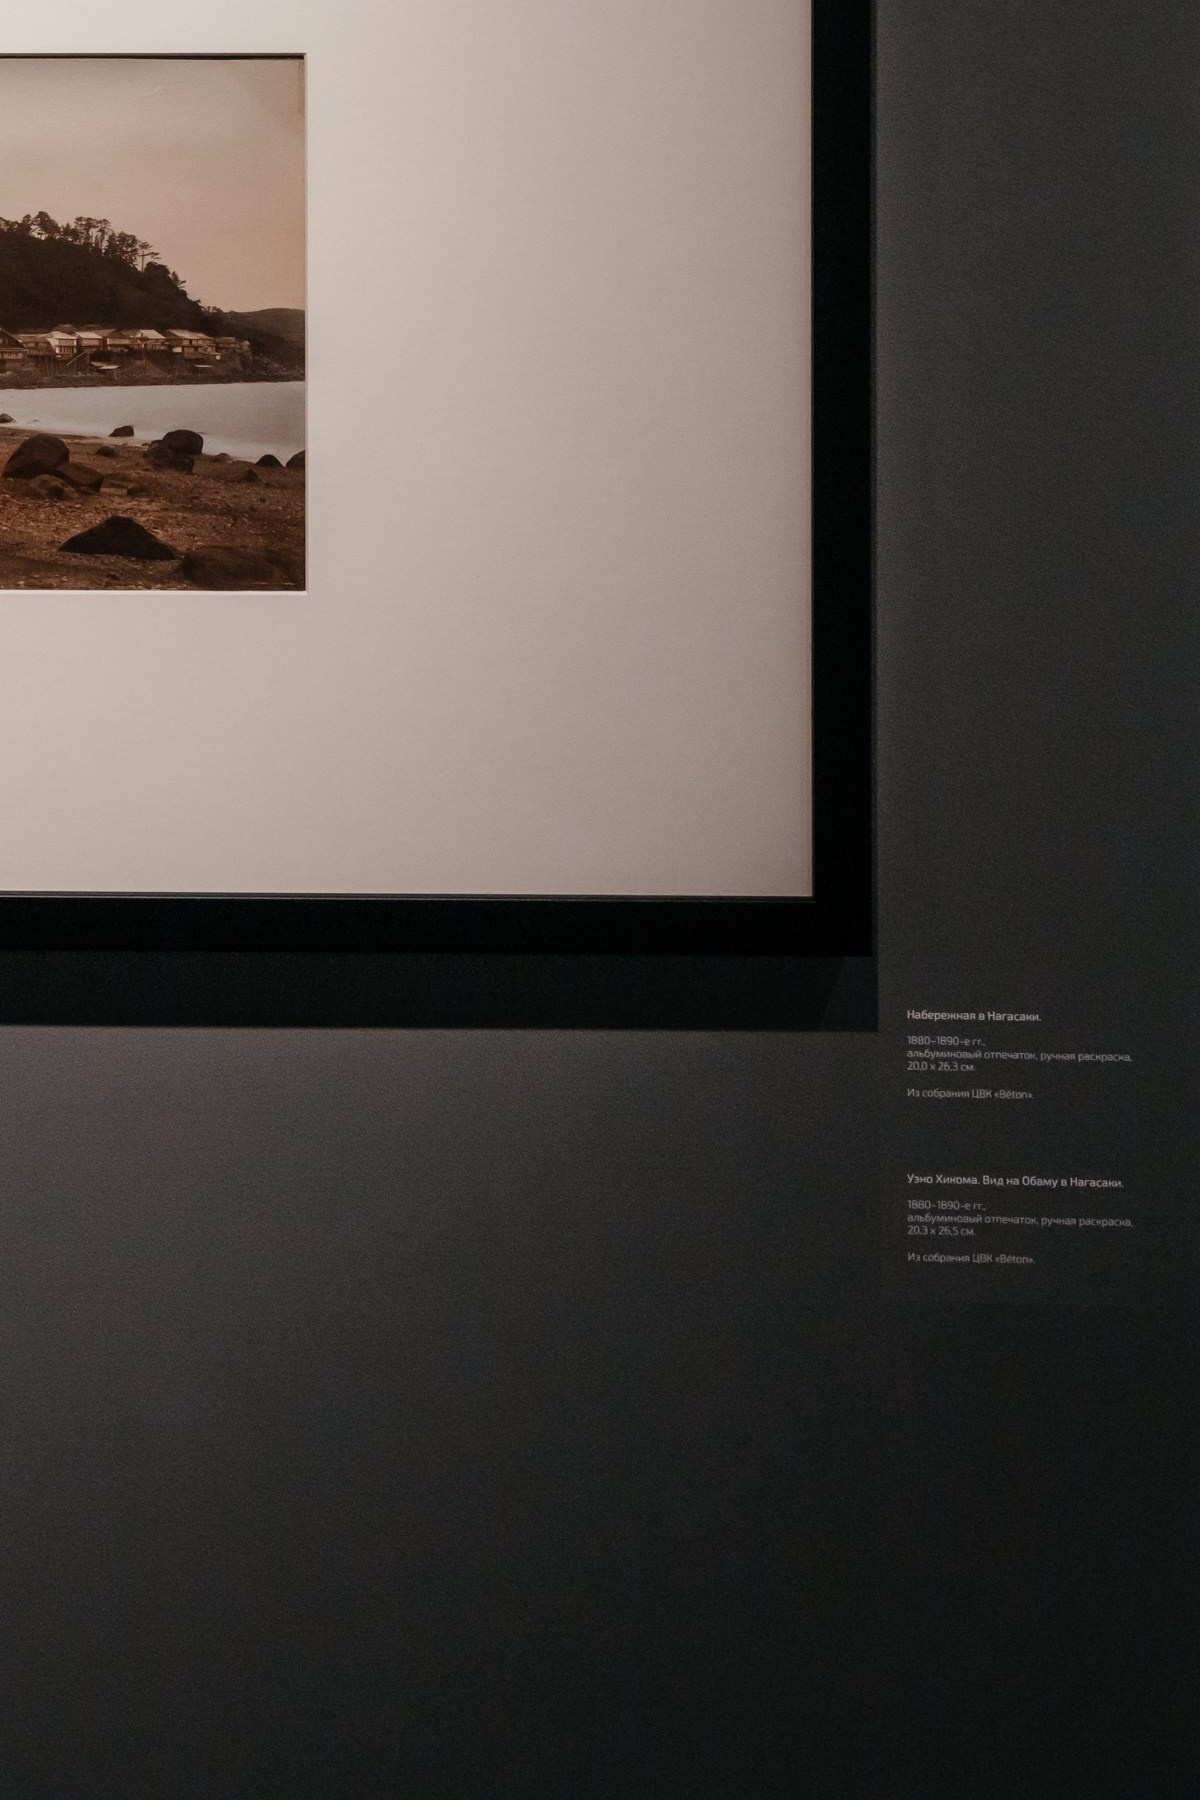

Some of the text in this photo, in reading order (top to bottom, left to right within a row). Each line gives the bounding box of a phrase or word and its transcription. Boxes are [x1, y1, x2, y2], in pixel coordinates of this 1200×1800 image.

[907, 1009, 1042, 1022] Набережная в Нагасаки.
[907, 1050, 1133, 1063] альбуминовый отпечаток, ручная раскраска,
[907, 1088, 920, 1097] Из
[922, 1088, 970, 1099] собрания
[971, 1089, 992, 1098] ЦВК
[907, 1173, 933, 1184] Уэно
[935, 1174, 980, 1185] Хикома.
[983, 1175, 1004, 1186] Вид
[1022, 1176, 1057, 1188] Обаму
[1069, 1177, 1124, 1188] Нагасаки.
[907, 1213, 1134, 1227] альбуминовый отпечаток, ручная раскраска,
[907, 1252, 920, 1262] Из
[922, 1252, 970, 1263] собрания
[972, 1253, 993, 1263] ЦВК
